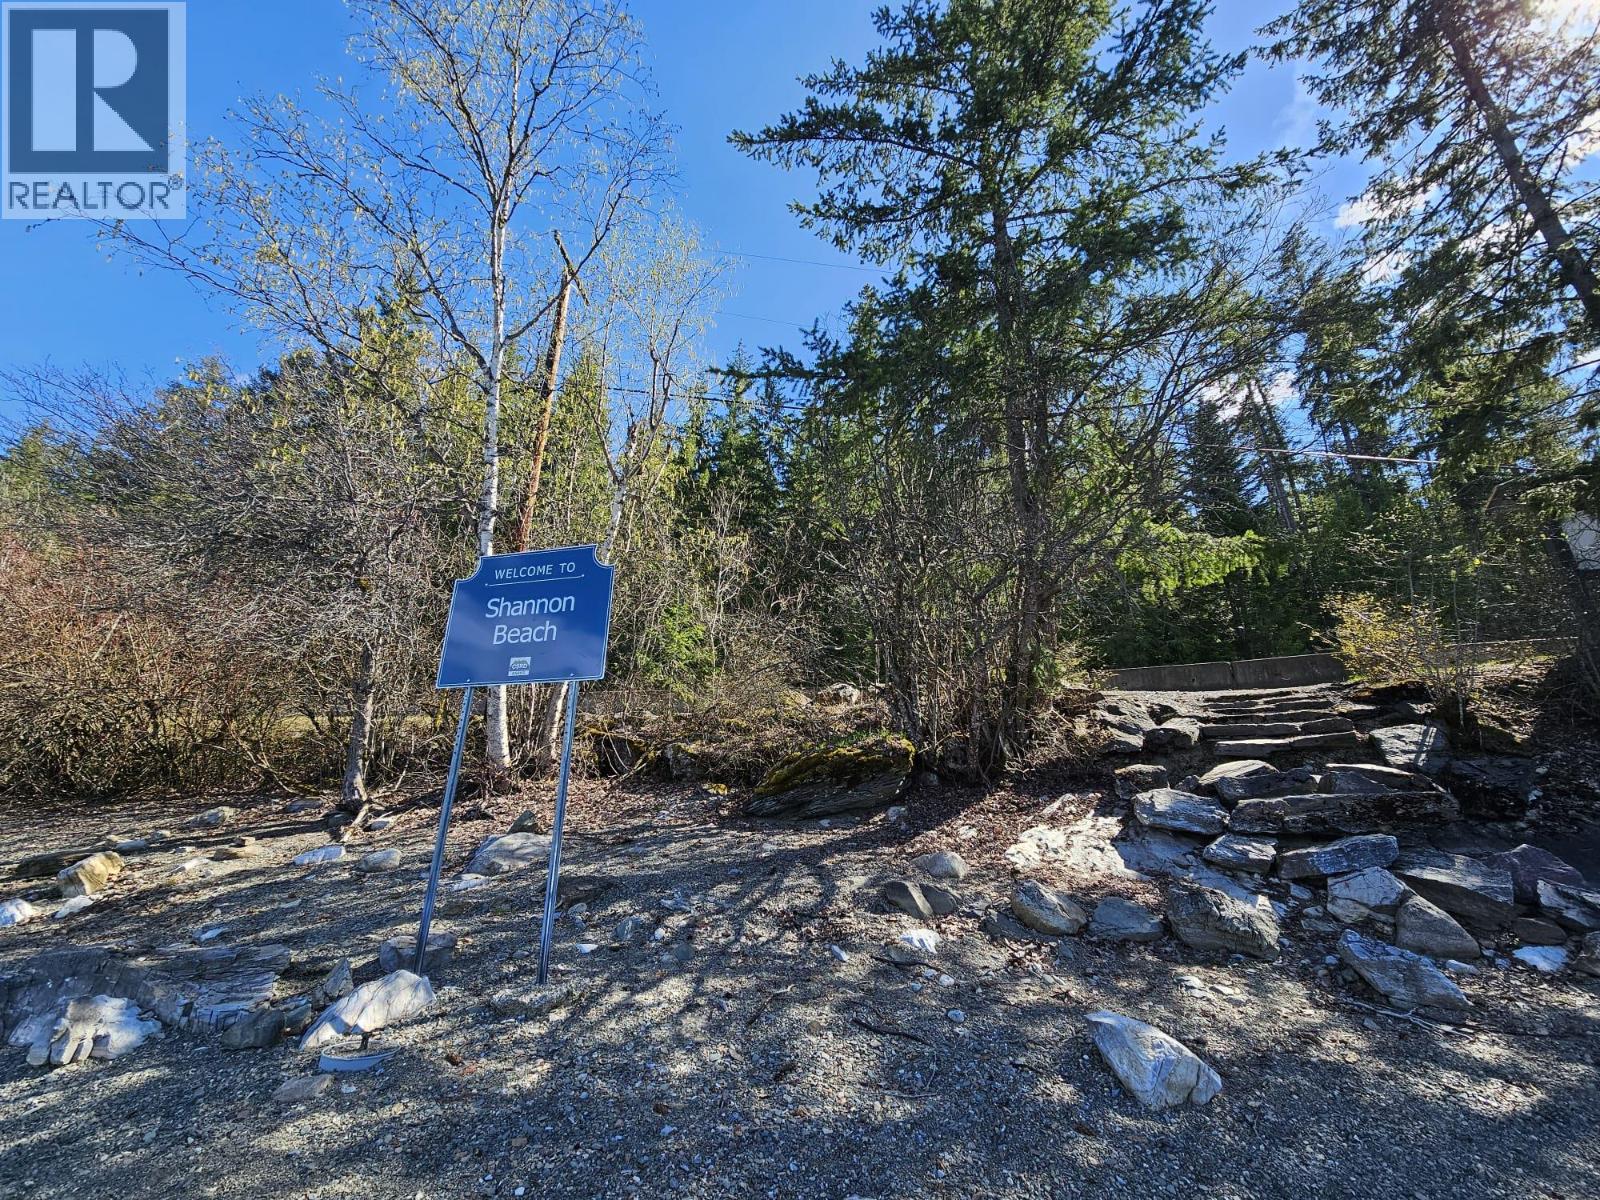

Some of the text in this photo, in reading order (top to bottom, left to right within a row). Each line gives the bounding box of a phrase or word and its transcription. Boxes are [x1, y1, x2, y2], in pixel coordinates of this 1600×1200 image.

[494, 562, 576, 580] WELCOME TO
[485, 595, 575, 618] Shannon
[493, 621, 557, 645] Beach
